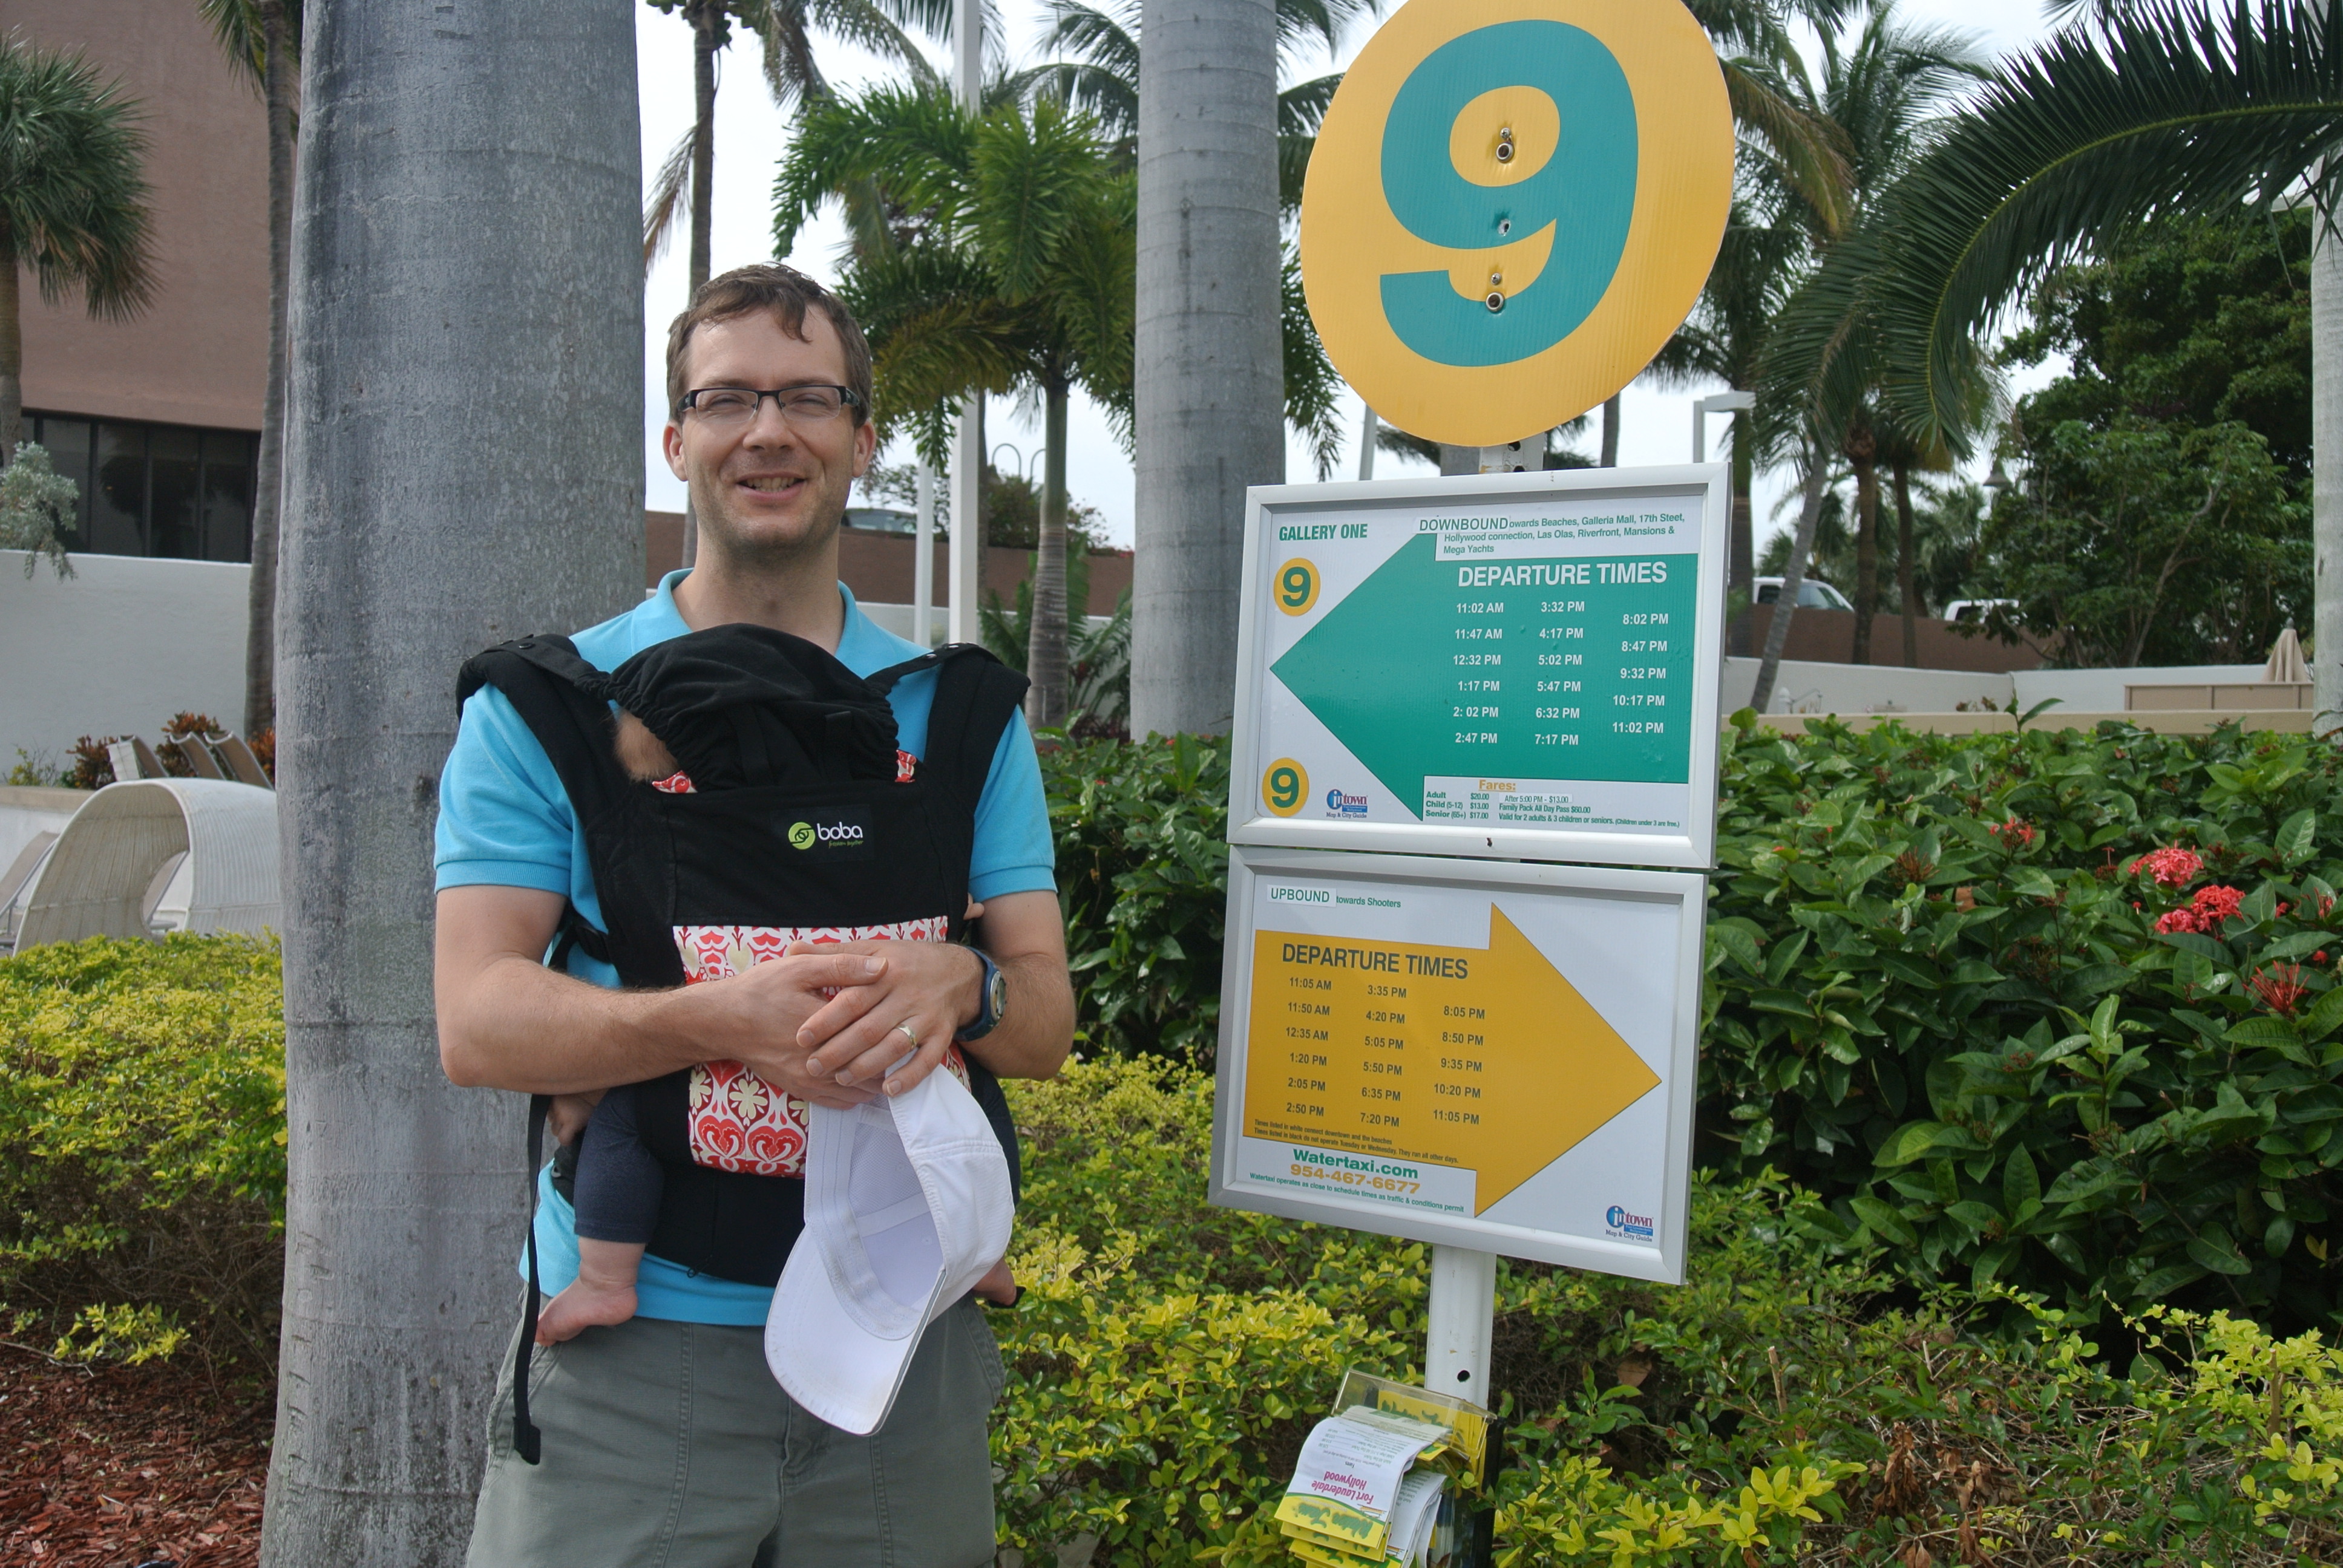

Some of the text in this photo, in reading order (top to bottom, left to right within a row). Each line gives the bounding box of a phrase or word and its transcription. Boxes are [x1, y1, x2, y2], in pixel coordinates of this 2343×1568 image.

[1380, 19, 1638, 367] 9
[1420, 513, 1685, 531] DOWNBOUND owards Beaches, Galleria Mall, 17th Steet,
[1279, 523, 1368, 541] GALLERY ONE
[1444, 533, 1486, 543] Hollywood
[1488, 531, 1535, 540] connection,
[1537, 530, 1552, 538] Las
[1555, 529, 1575, 538] Olas,
[1578, 528, 1621, 538] Riverfront,
[1624, 526, 1665, 535] Mansions
[1444, 545, 1494, 555] Mega Yachts
[1458, 561, 1667, 587] DEPARTURE TIMES
[1282, 566, 1311, 607] 9
[1457, 603, 1504, 613] 11:02 AM
[1541, 601, 1585, 612] 3:32 PM
[1622, 613, 1668, 624] 8:02 PM
[1455, 629, 1502, 639] 11:47 AM
[1621, 641, 1667, 652] 8:47 PM
[1453, 655, 1501, 665] 12:32 PM
[1538, 655, 1582, 665] 5:02 PM
[1620, 668, 1666, 679] 9:32 PM
[1458, 681, 1500, 691] 1:17 PM
[1537, 681, 1581, 691] 5:47 PM
[1613, 695, 1665, 706] 10:17 PM
[1536, 708, 1580, 718] 6:32 PM
[1612, 722, 1663, 733] 11:02 PM
[1455, 733, 1498, 743] 2:47 PM
[1535, 734, 1578, 745] 7:17 PM
[1271, 767, 1299, 808] 9
[1479, 779, 1516, 791] Fares:
[817, 822, 863, 840] boba
[1271, 888, 1401, 907] UPBOUND towards Shooters
[1282, 943, 1468, 979] DEPARTURE TIMES
[1289, 977, 1331, 990] 11:05 AM
[1368, 985, 1406, 998] 3:35 PM
[1288, 1002, 1330, 1016] 11:50 AM
[1443, 1005, 1485, 1019] 8:05 PM
[1366, 1010, 1405, 1024] 4:20 PM
[1286, 1027, 1328, 1041] 12:35 AM
[1442, 1032, 1483, 1046] 8:50 PM
[1365, 1036, 1403, 1050] 5:05 PM
[1289, 1053, 1327, 1066] 1:20 PM
[1441, 1058, 1482, 1072] 9:35 PM
[1288, 1077, 1326, 1091] 2:05 PM
[1434, 1083, 1481, 1099] 10:20 PM
[1362, 1087, 1401, 1102] 6:35 PM
[1286, 1102, 1324, 1117] 2:50 PM
[1360, 1112, 1400, 1127] 7:20 PM
[1434, 1109, 1480, 1125] 11:05 PM
[1293, 1148, 1418, 1178] Watertaxi.com
[1290, 1164, 1420, 1194] 954-467-6677
[1250, 1172, 1275, 1182] Watertaxi
[1276, 1177, 1300, 1186] operates
[1334, 1186, 1360, 1196] schedule
[1387, 1194, 1404, 1203] traffic
[1412, 1199, 1443, 1209] conditions
[1323, 1471, 1367, 1490] Hollywood
[1311, 1480, 1356, 1500] Lauderdale
[1356, 1491, 1374, 1504] Fort
